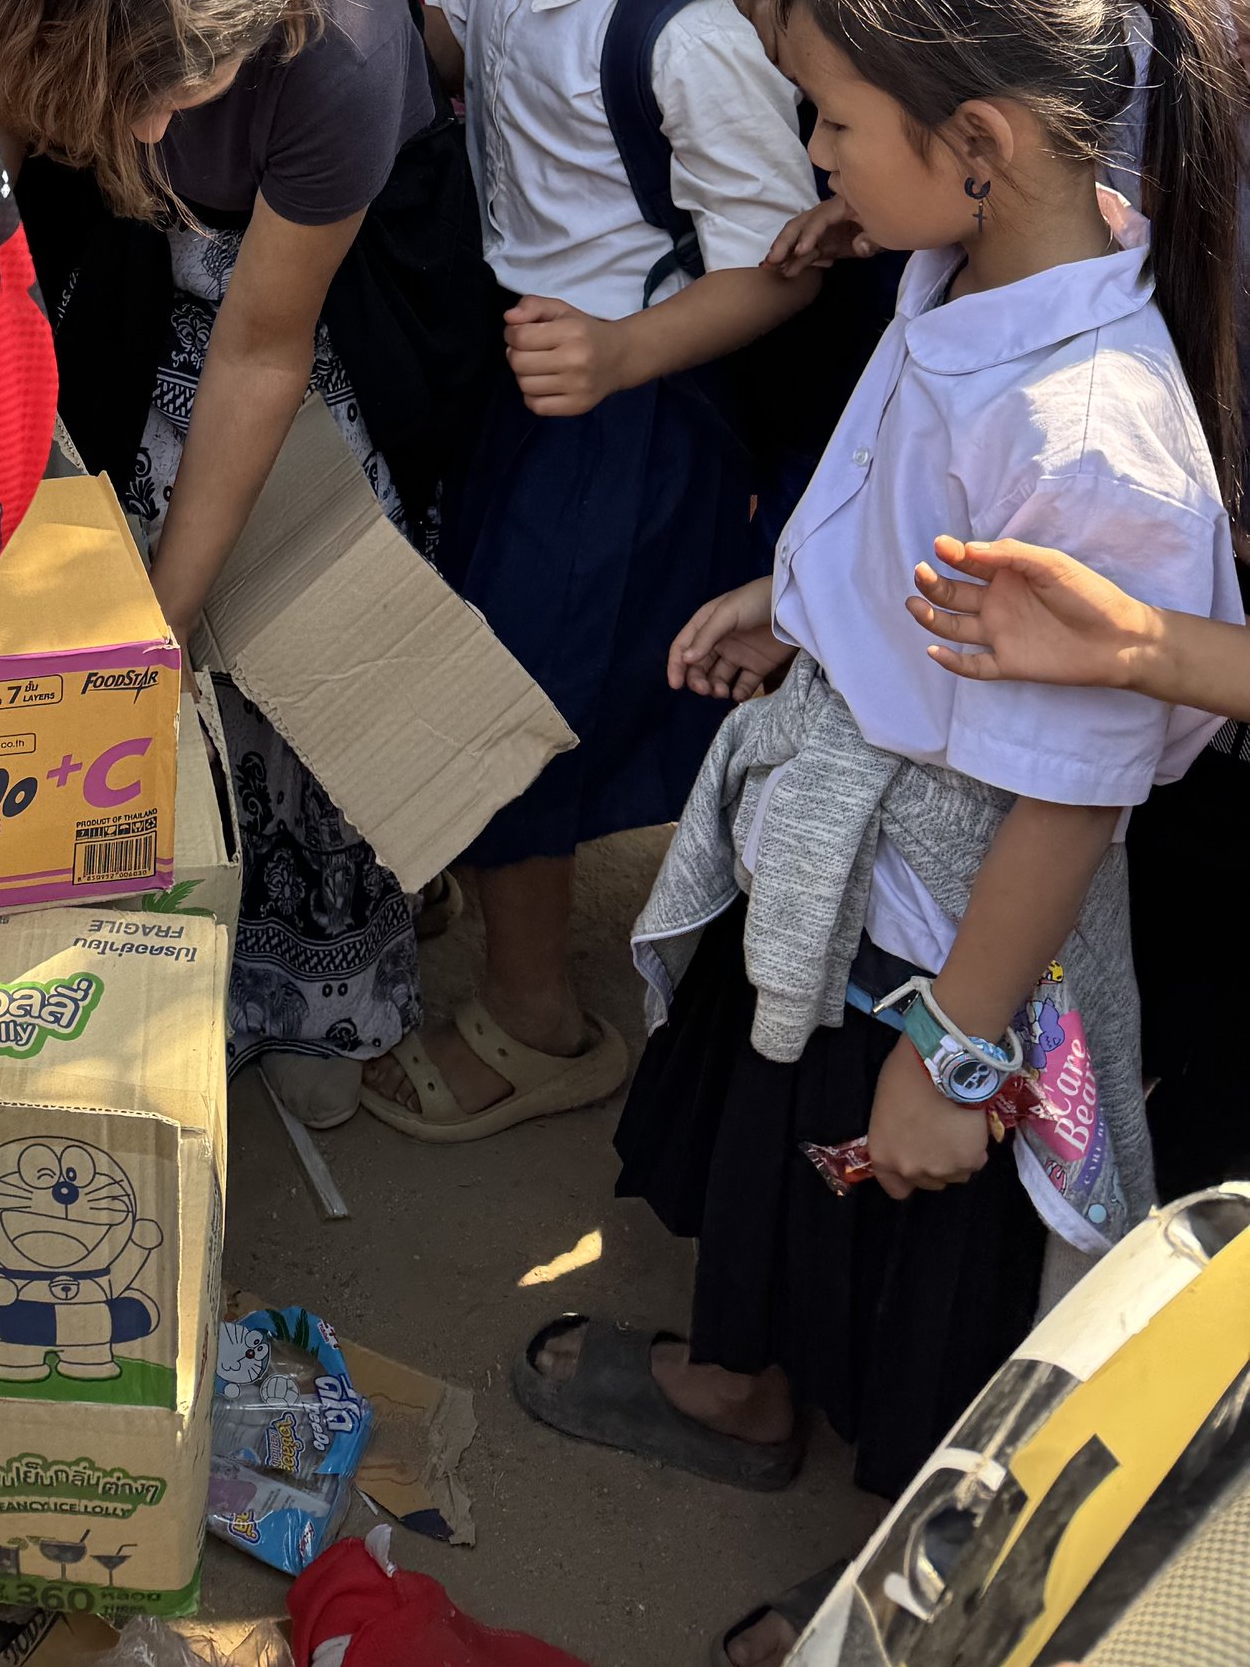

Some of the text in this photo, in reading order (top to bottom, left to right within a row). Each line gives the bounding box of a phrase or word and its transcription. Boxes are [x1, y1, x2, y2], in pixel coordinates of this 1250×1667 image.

[7, 685, 22, 705] 7
[23, 692, 56, 703] LAYERS
[75, 807, 158, 829] PRODUCT OF THAILAND
[88, 919, 185, 939] FRAGILE
[72, 937, 198, 963] โปรดอย่าโยน
[53, 1501, 79, 1513] ICE
[83, 1504, 132, 1518] LOLLY
[16, 1583, 96, 1613] 360
